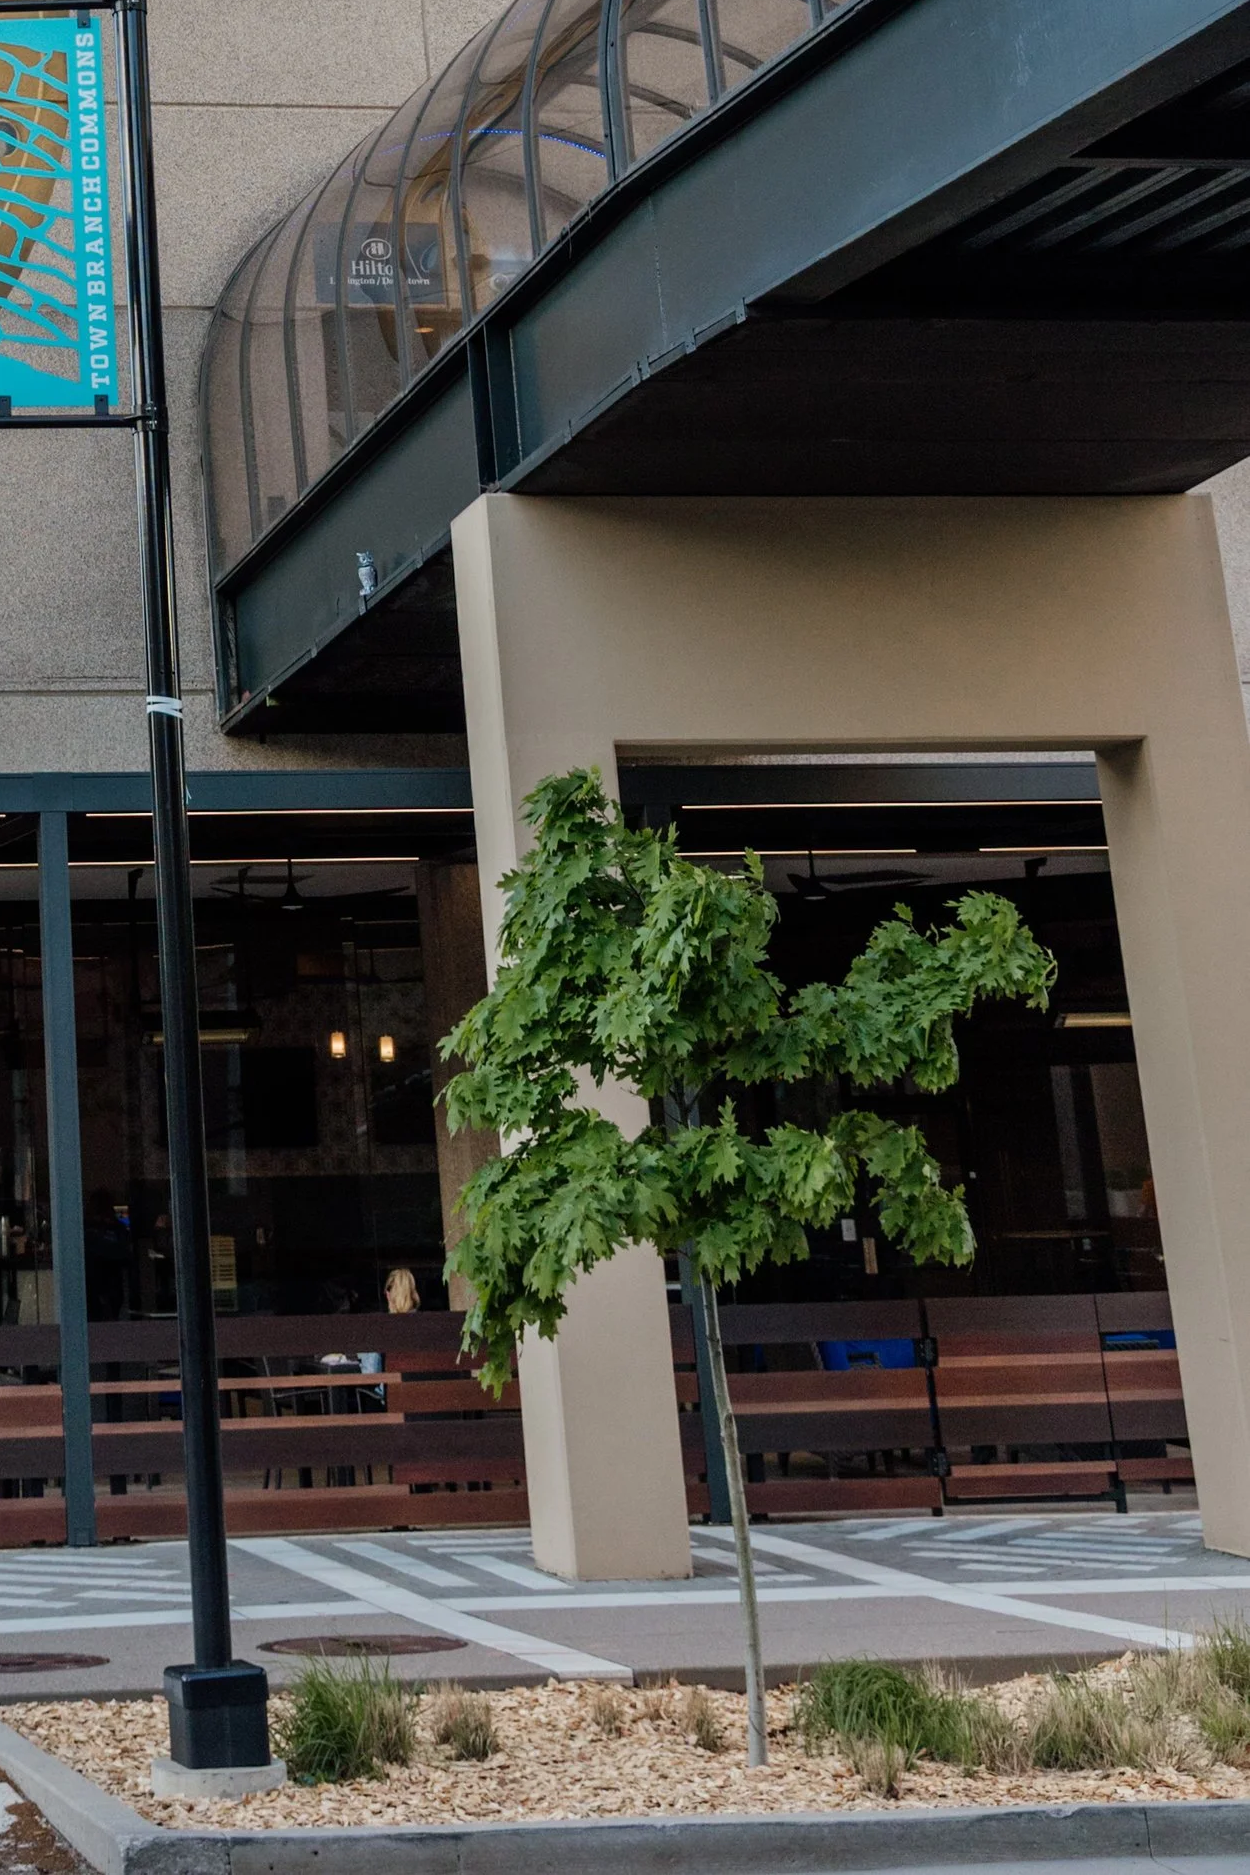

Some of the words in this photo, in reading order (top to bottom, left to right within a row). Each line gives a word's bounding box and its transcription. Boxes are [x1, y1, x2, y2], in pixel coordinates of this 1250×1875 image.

[75, 32, 101, 170] COMMONS
[82, 176, 106, 296] BRANCH
[351, 260, 394, 276] Hilto
[330, 276, 375, 286] Lington
[382, 276, 430, 285] Dotown
[88, 303, 110, 389] TOWN
